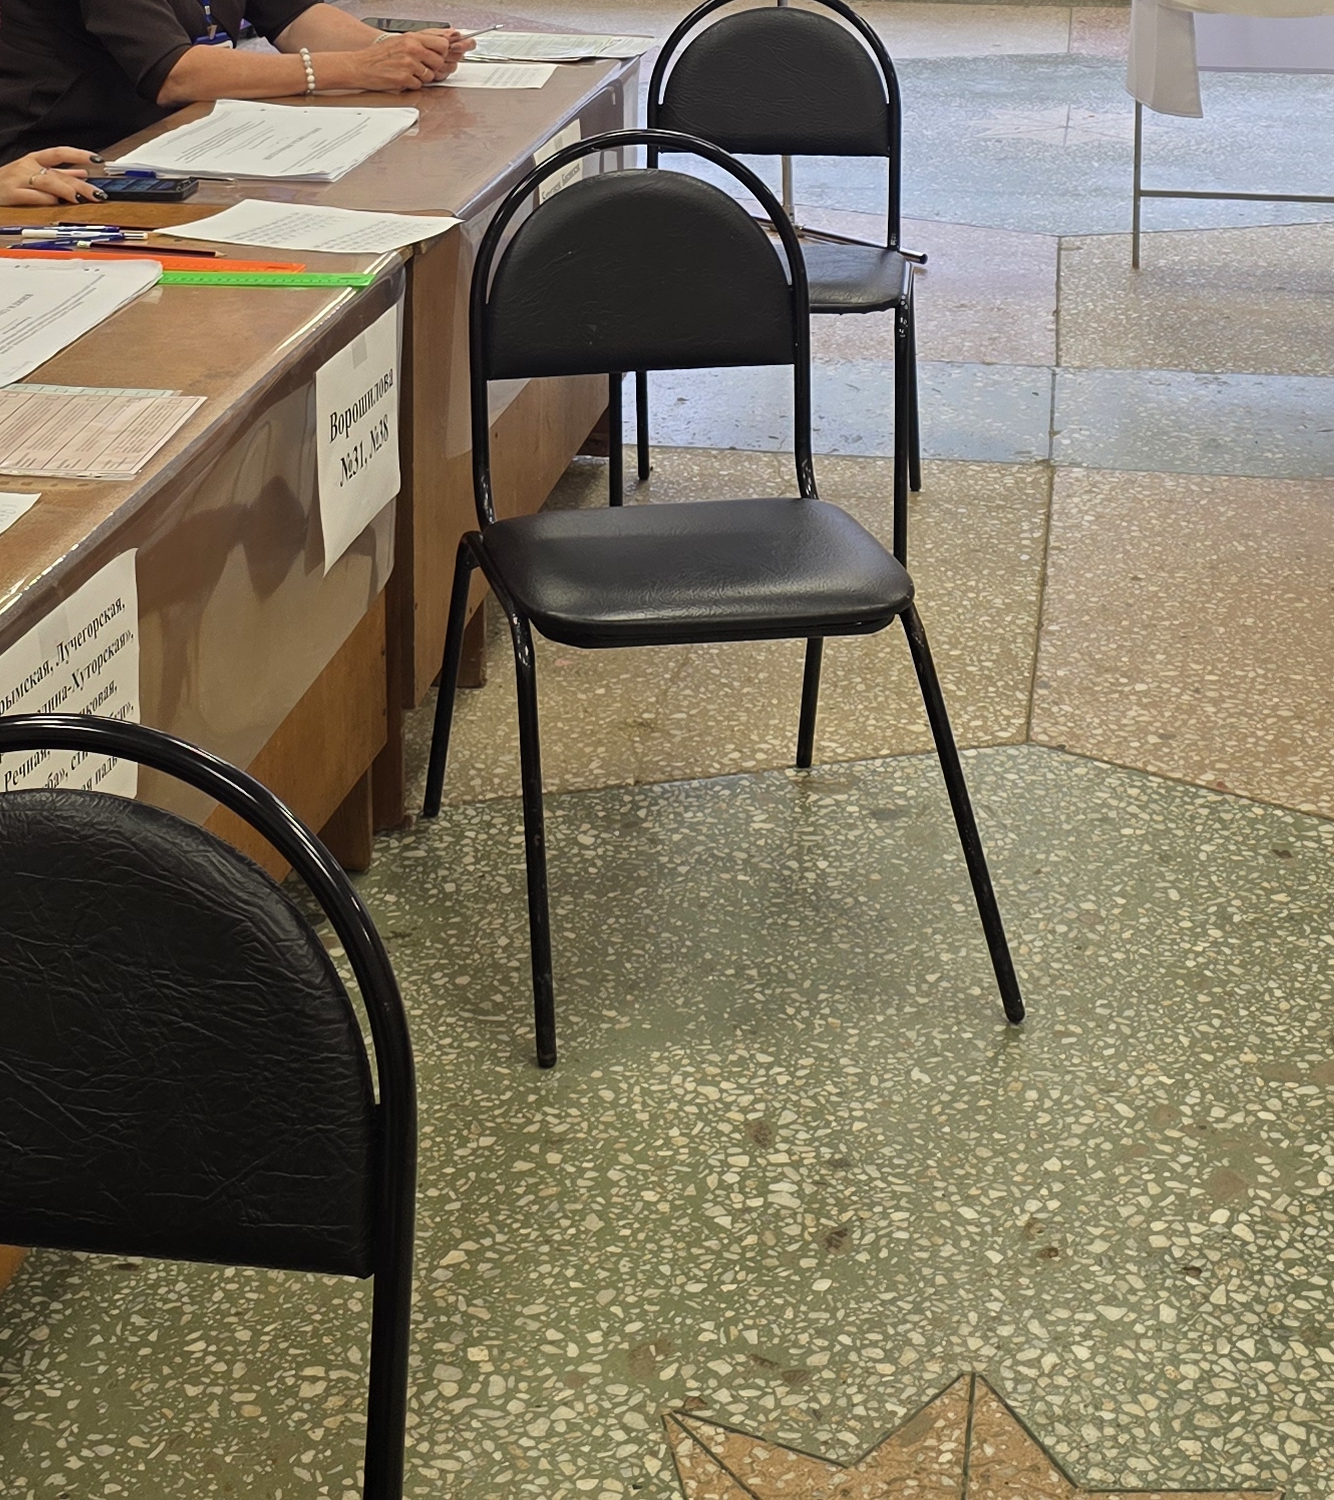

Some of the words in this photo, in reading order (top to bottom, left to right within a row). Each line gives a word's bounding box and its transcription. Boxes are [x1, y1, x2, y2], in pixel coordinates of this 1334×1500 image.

[328, 368, 394, 445] Ворошилова
[339, 440, 368, 488] №31,
[369, 413, 389, 460] №38
[55, 597, 126, 666] Лучегорская,
[35, 629, 135, 714] лина-Хуторская»,
